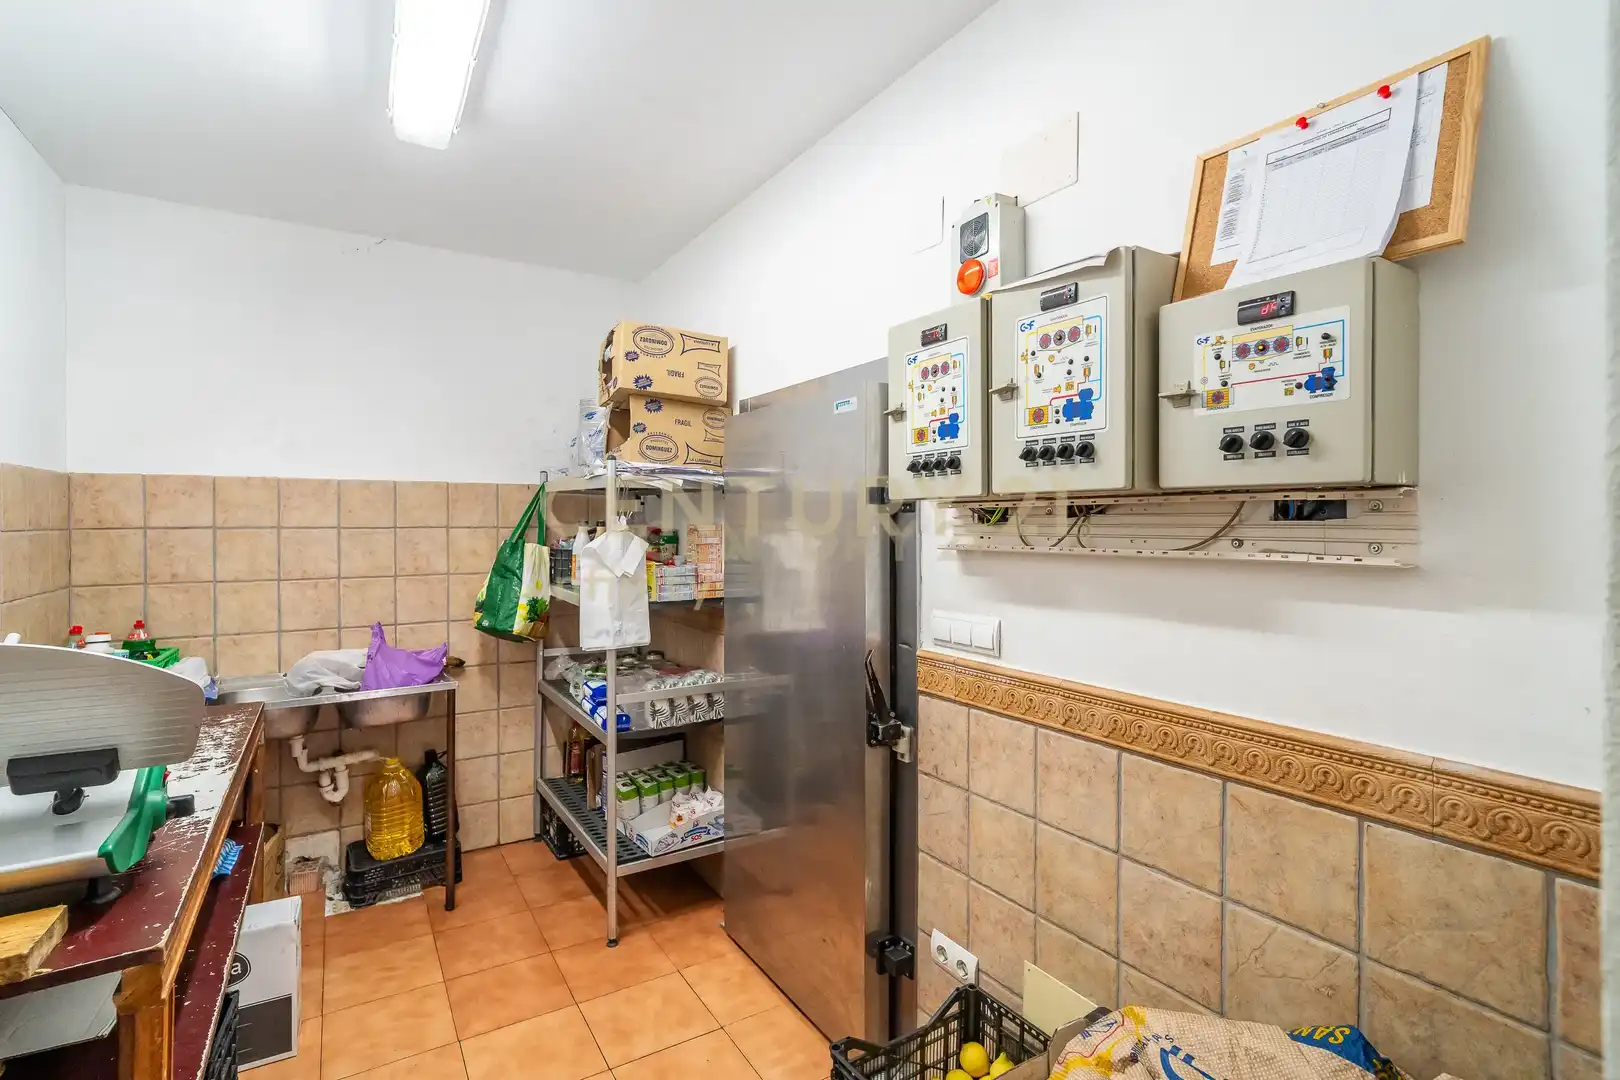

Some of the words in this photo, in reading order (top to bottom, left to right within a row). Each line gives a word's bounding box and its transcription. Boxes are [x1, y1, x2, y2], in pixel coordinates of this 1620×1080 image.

[639, 336, 668, 346] DOMINGUEZ
[674, 418, 692, 427] FRAGIL
[645, 444, 673, 453] DOMINGUEZ
[1292, 1025, 1351, 1044] SAN
